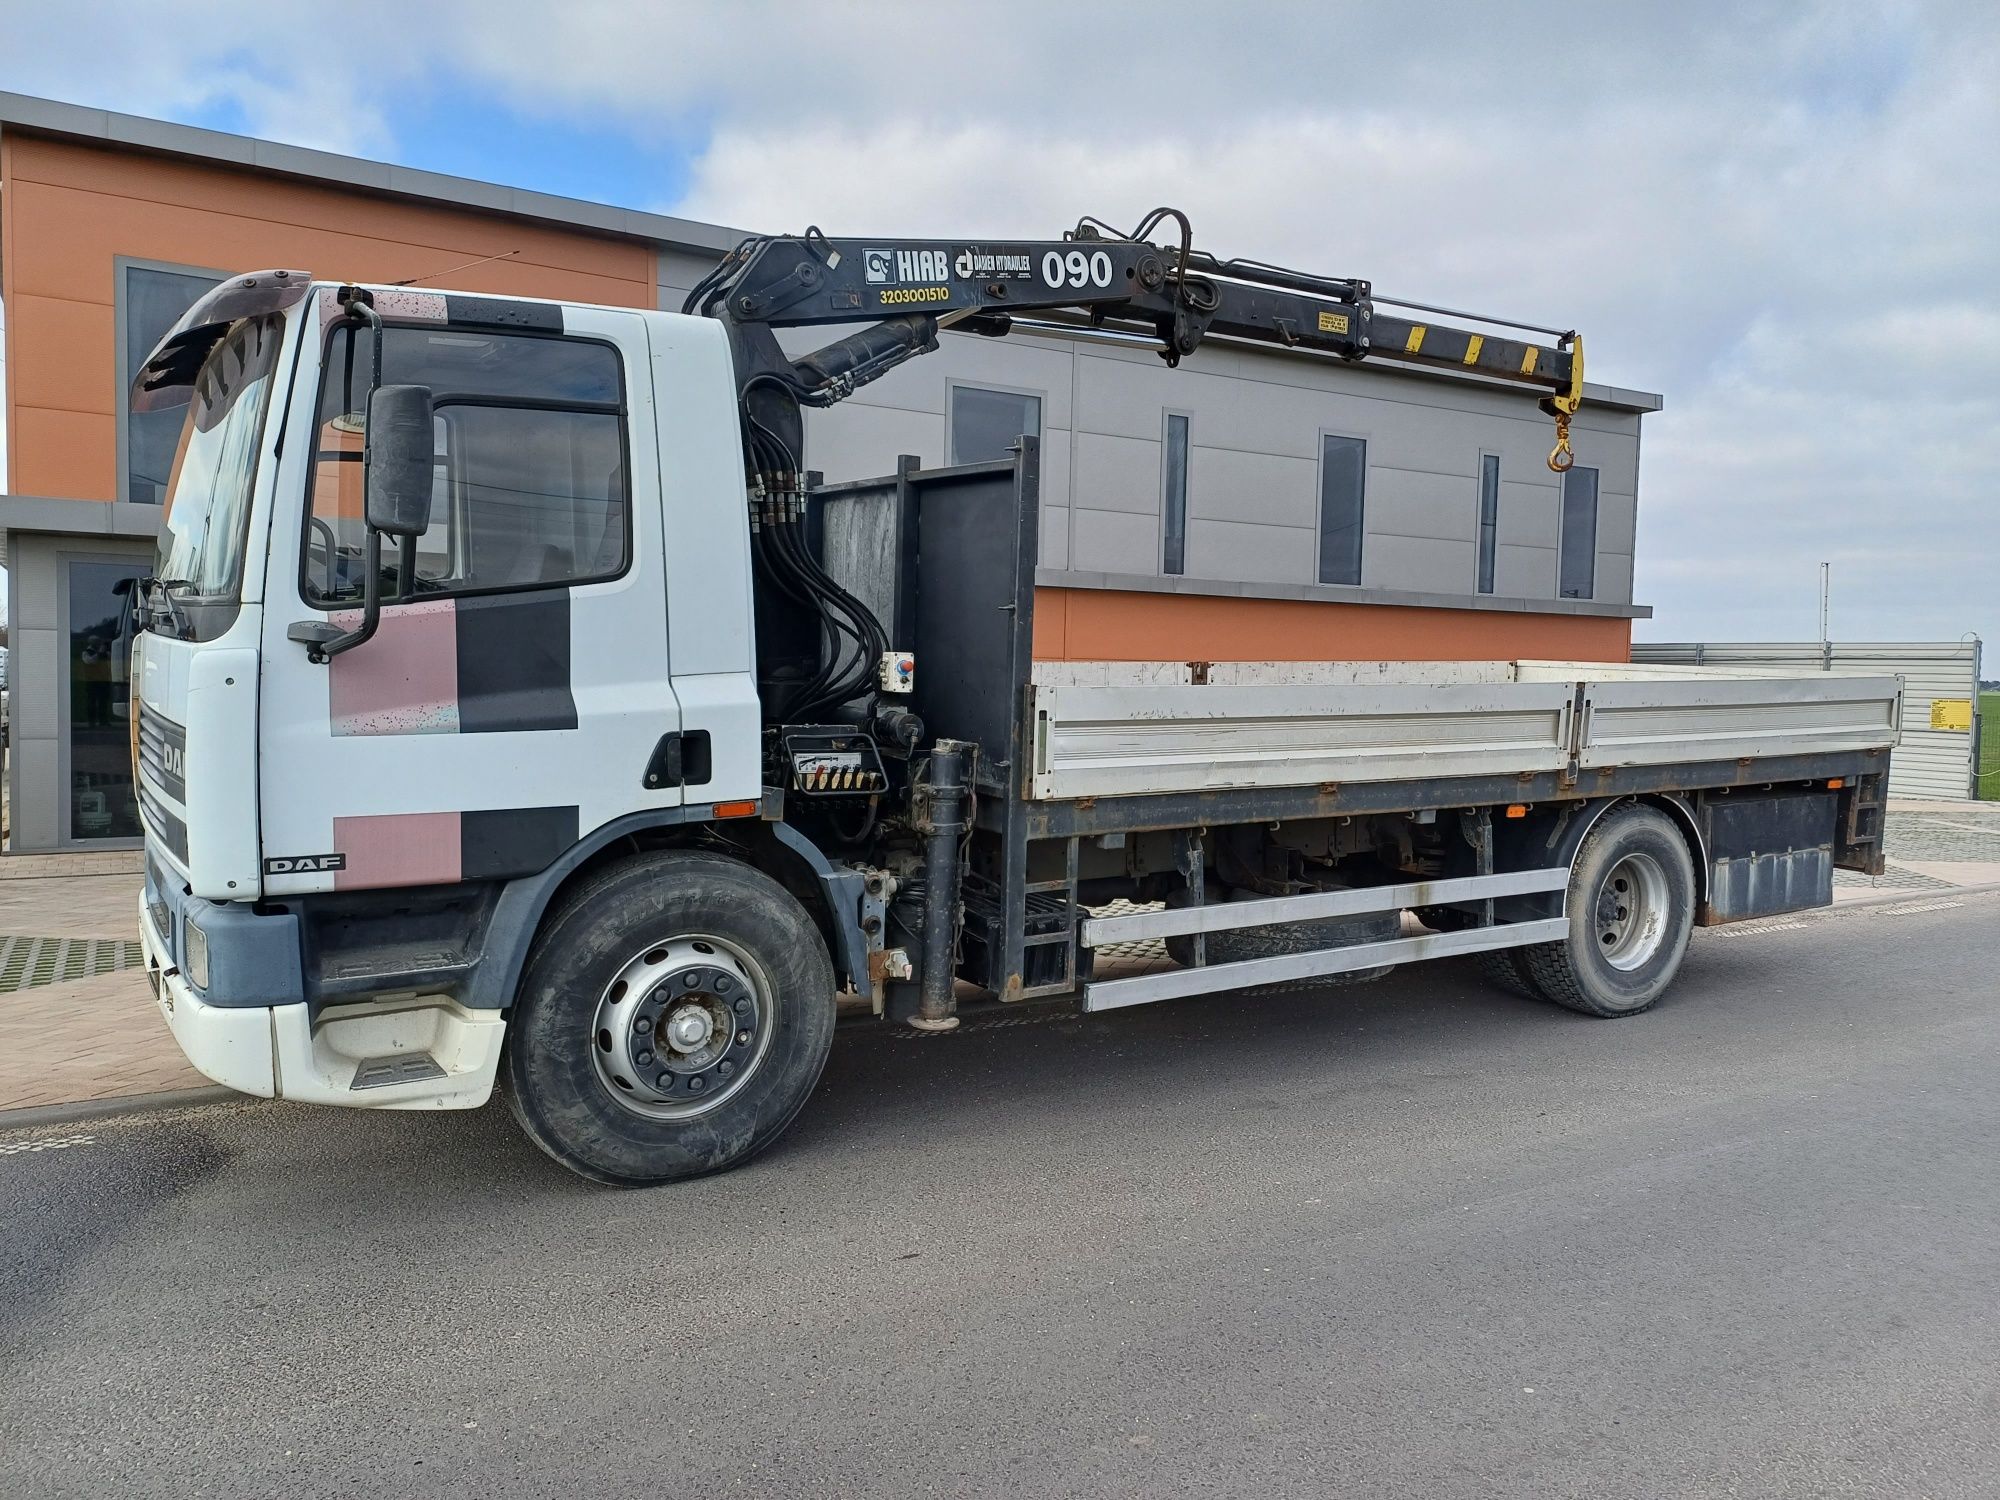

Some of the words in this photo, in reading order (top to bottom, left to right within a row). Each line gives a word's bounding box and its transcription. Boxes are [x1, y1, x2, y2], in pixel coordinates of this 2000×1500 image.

[896, 250, 949, 282] HIAB
[1042, 250, 1113, 288] 090
[879, 287, 949, 304] 3203001510
[164, 742, 186, 780] DA
[269, 856, 341, 873] DAF
